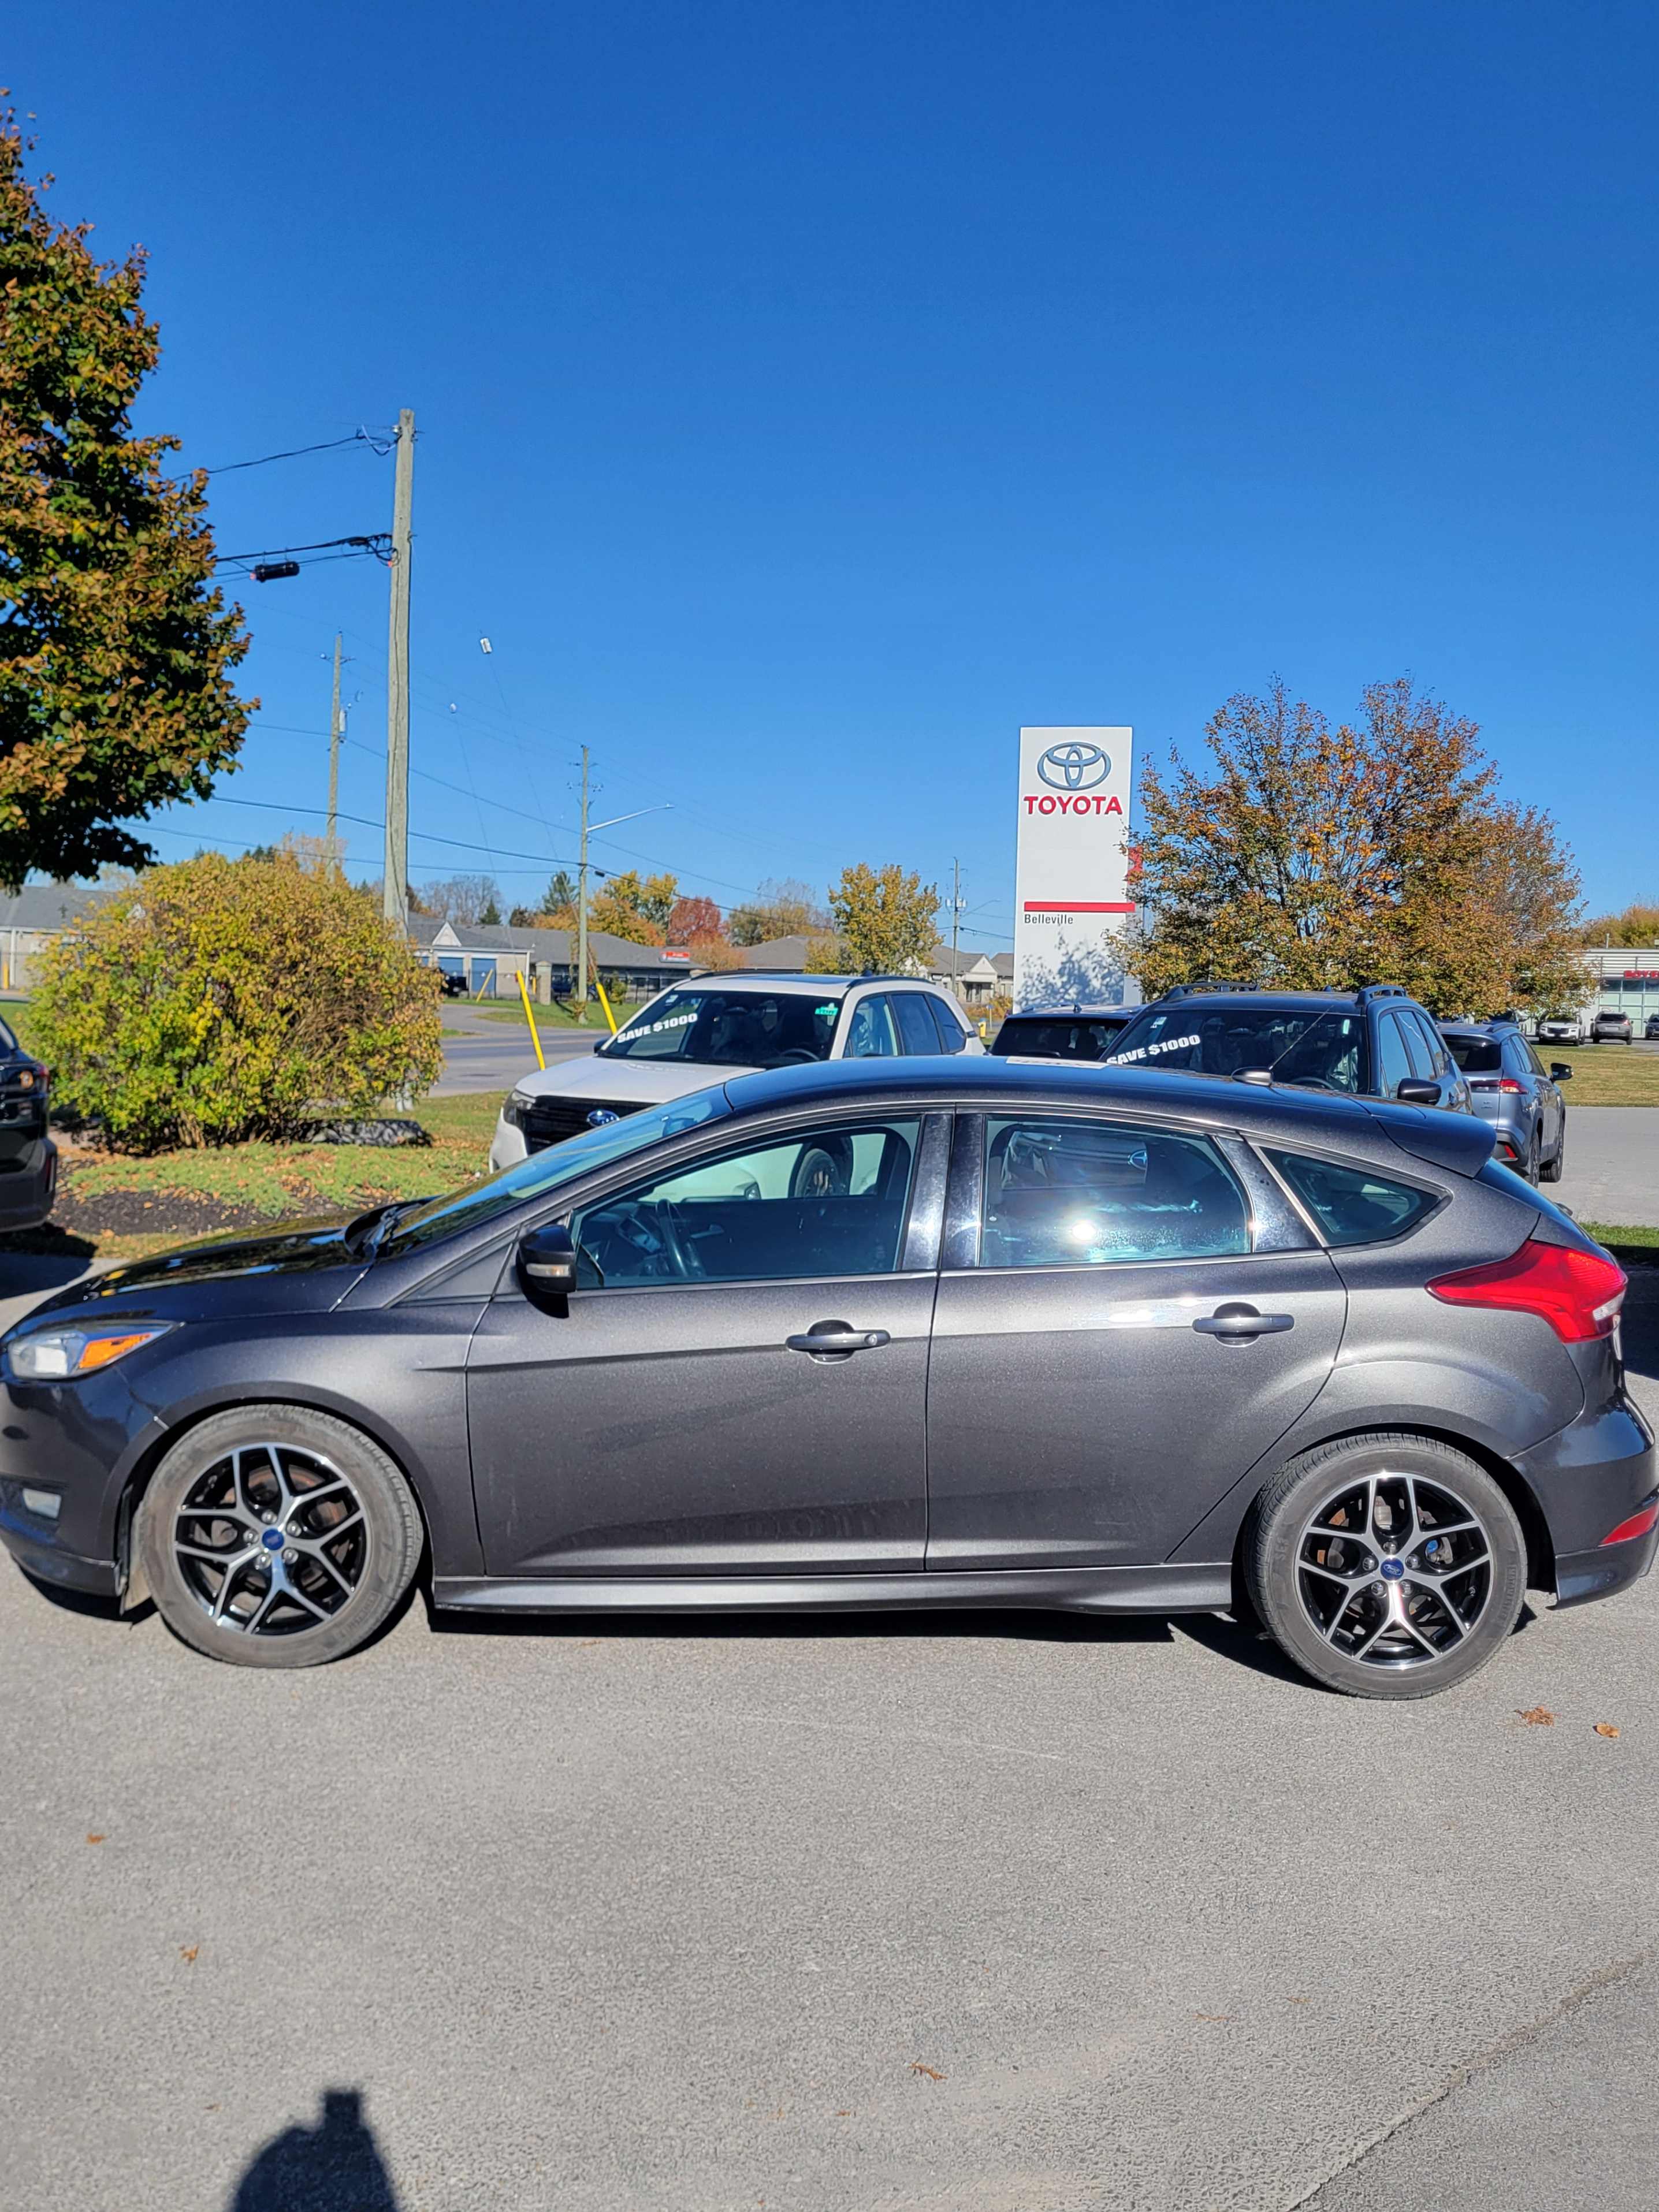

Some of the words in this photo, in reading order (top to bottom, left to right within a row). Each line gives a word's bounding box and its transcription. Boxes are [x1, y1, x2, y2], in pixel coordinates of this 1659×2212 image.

[1024, 796, 1122, 814] TOYOTA
[1024, 914, 1073, 925] Belleville
[617, 1025, 651, 1043] SAVE
[653, 1013, 698, 1032] $1000
[1107, 1048, 1147, 1064] SAVE
[1148, 1034, 1201, 1055] $1000
